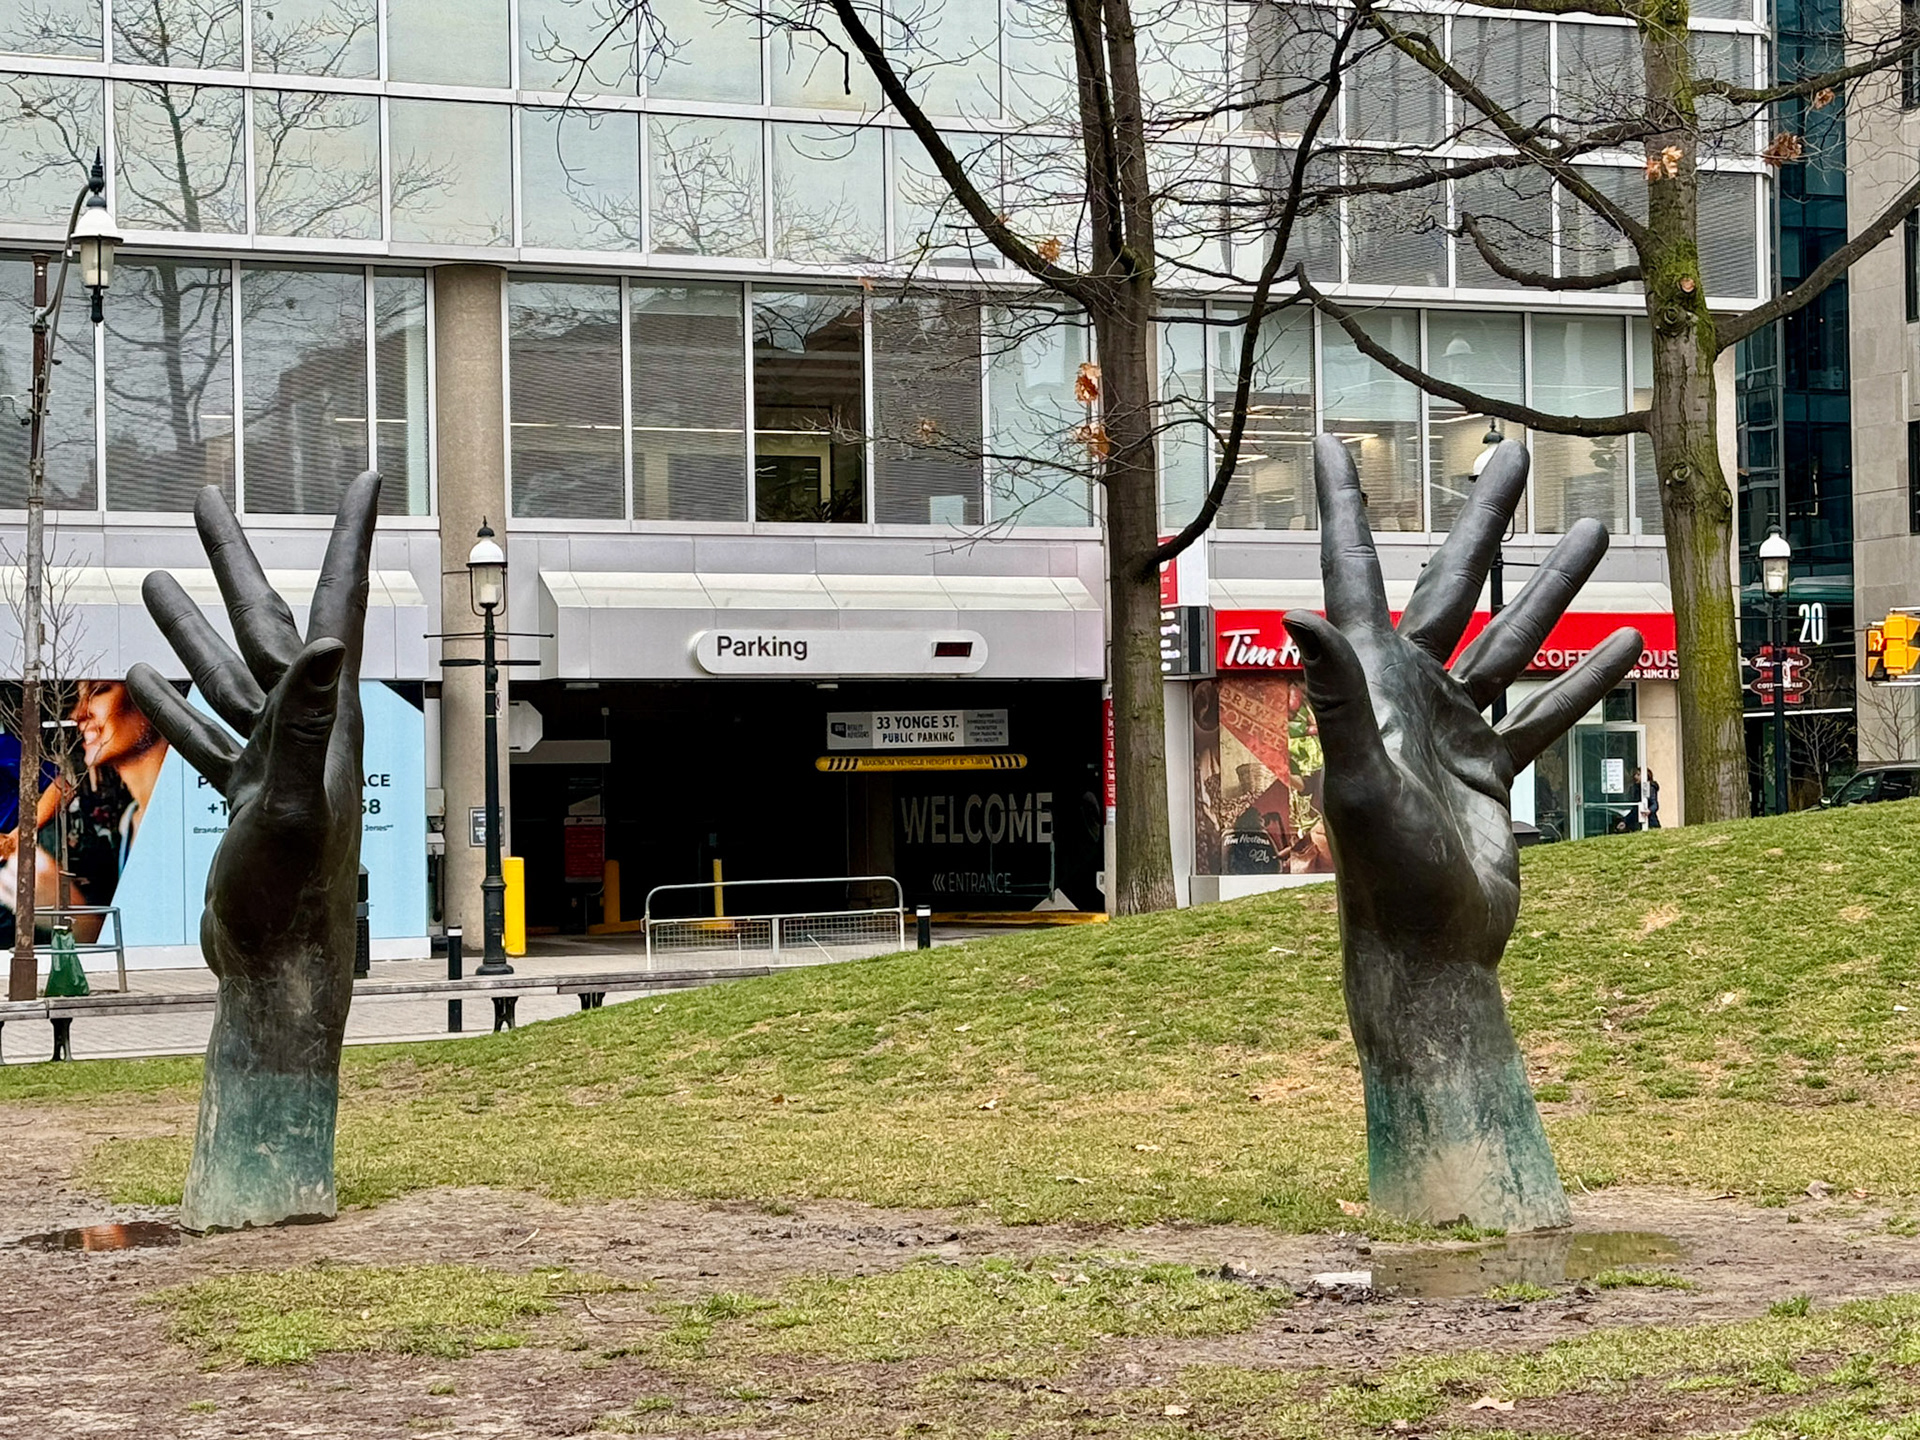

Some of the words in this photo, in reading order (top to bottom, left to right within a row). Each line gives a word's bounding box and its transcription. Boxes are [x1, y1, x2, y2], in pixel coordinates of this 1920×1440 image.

[1798, 602, 1824, 645] 20
[716, 635, 808, 660] Parking
[1220, 628, 1276, 667] Tim
[1638, 649, 1678, 667] OUS
[877, 717, 890, 729] 33
[895, 715, 938, 729] YONGE
[943, 715, 959, 729] ST.
[882, 733, 913, 743] PUBLIC
[917, 732, 955, 743] PARKING
[900, 792, 1053, 844] WELCOME
[949, 872, 1012, 894] ENTRANCE
